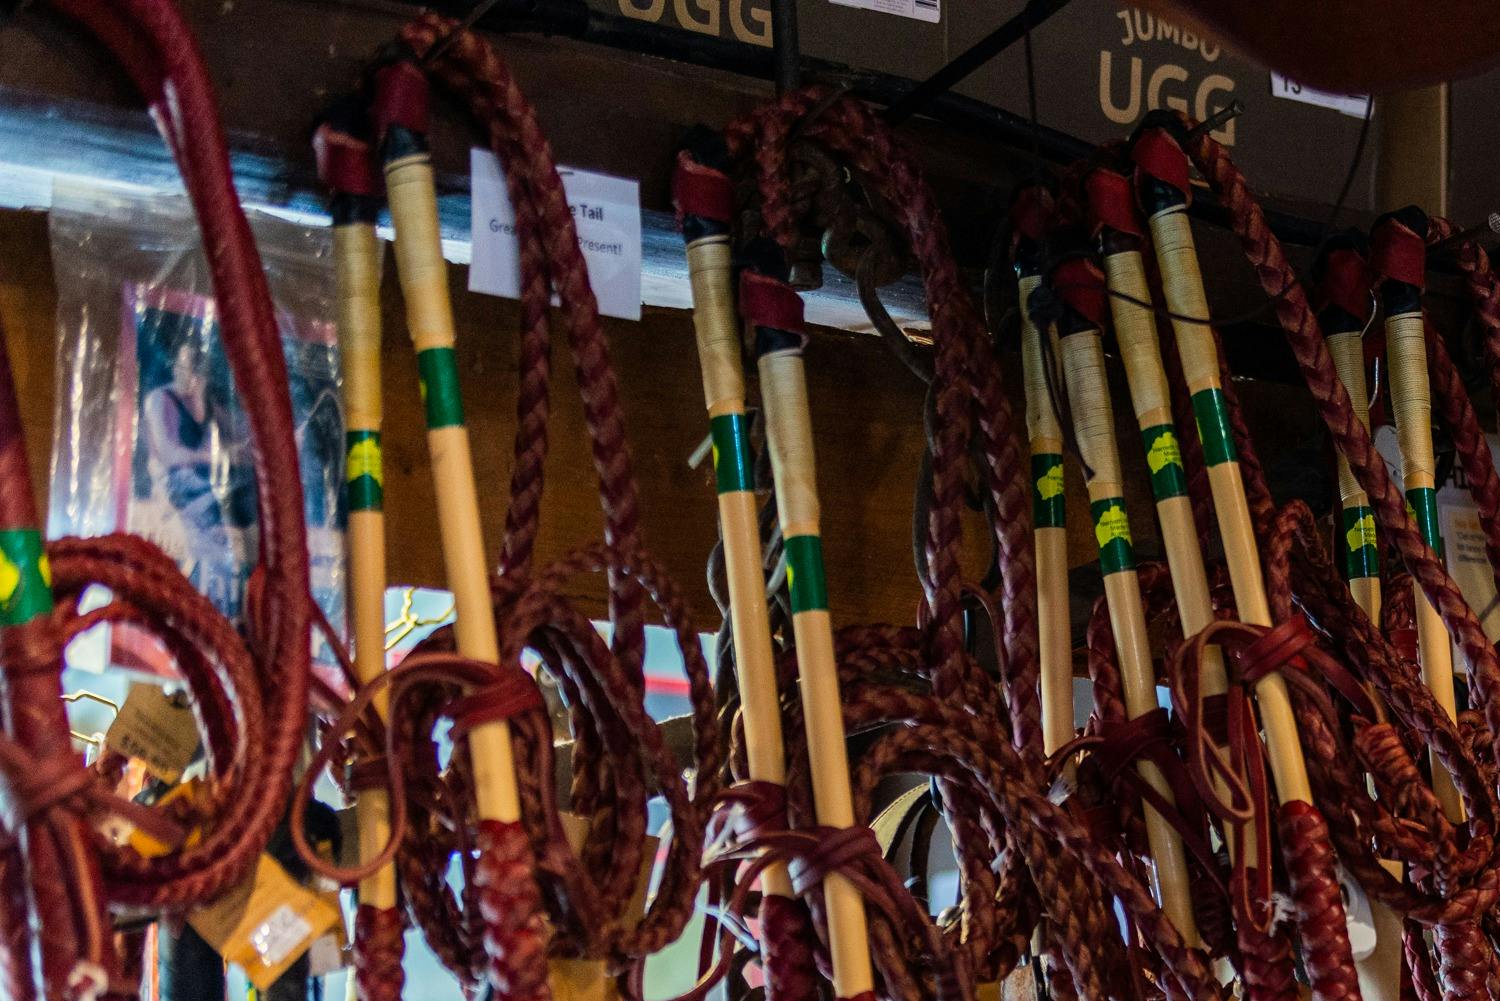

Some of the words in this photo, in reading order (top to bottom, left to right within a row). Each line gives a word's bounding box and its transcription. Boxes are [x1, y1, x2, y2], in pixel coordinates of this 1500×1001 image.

[1101, 51, 1236, 147] UGG
[580, 204, 604, 221] Tail
[489, 219, 516, 236] Grea
